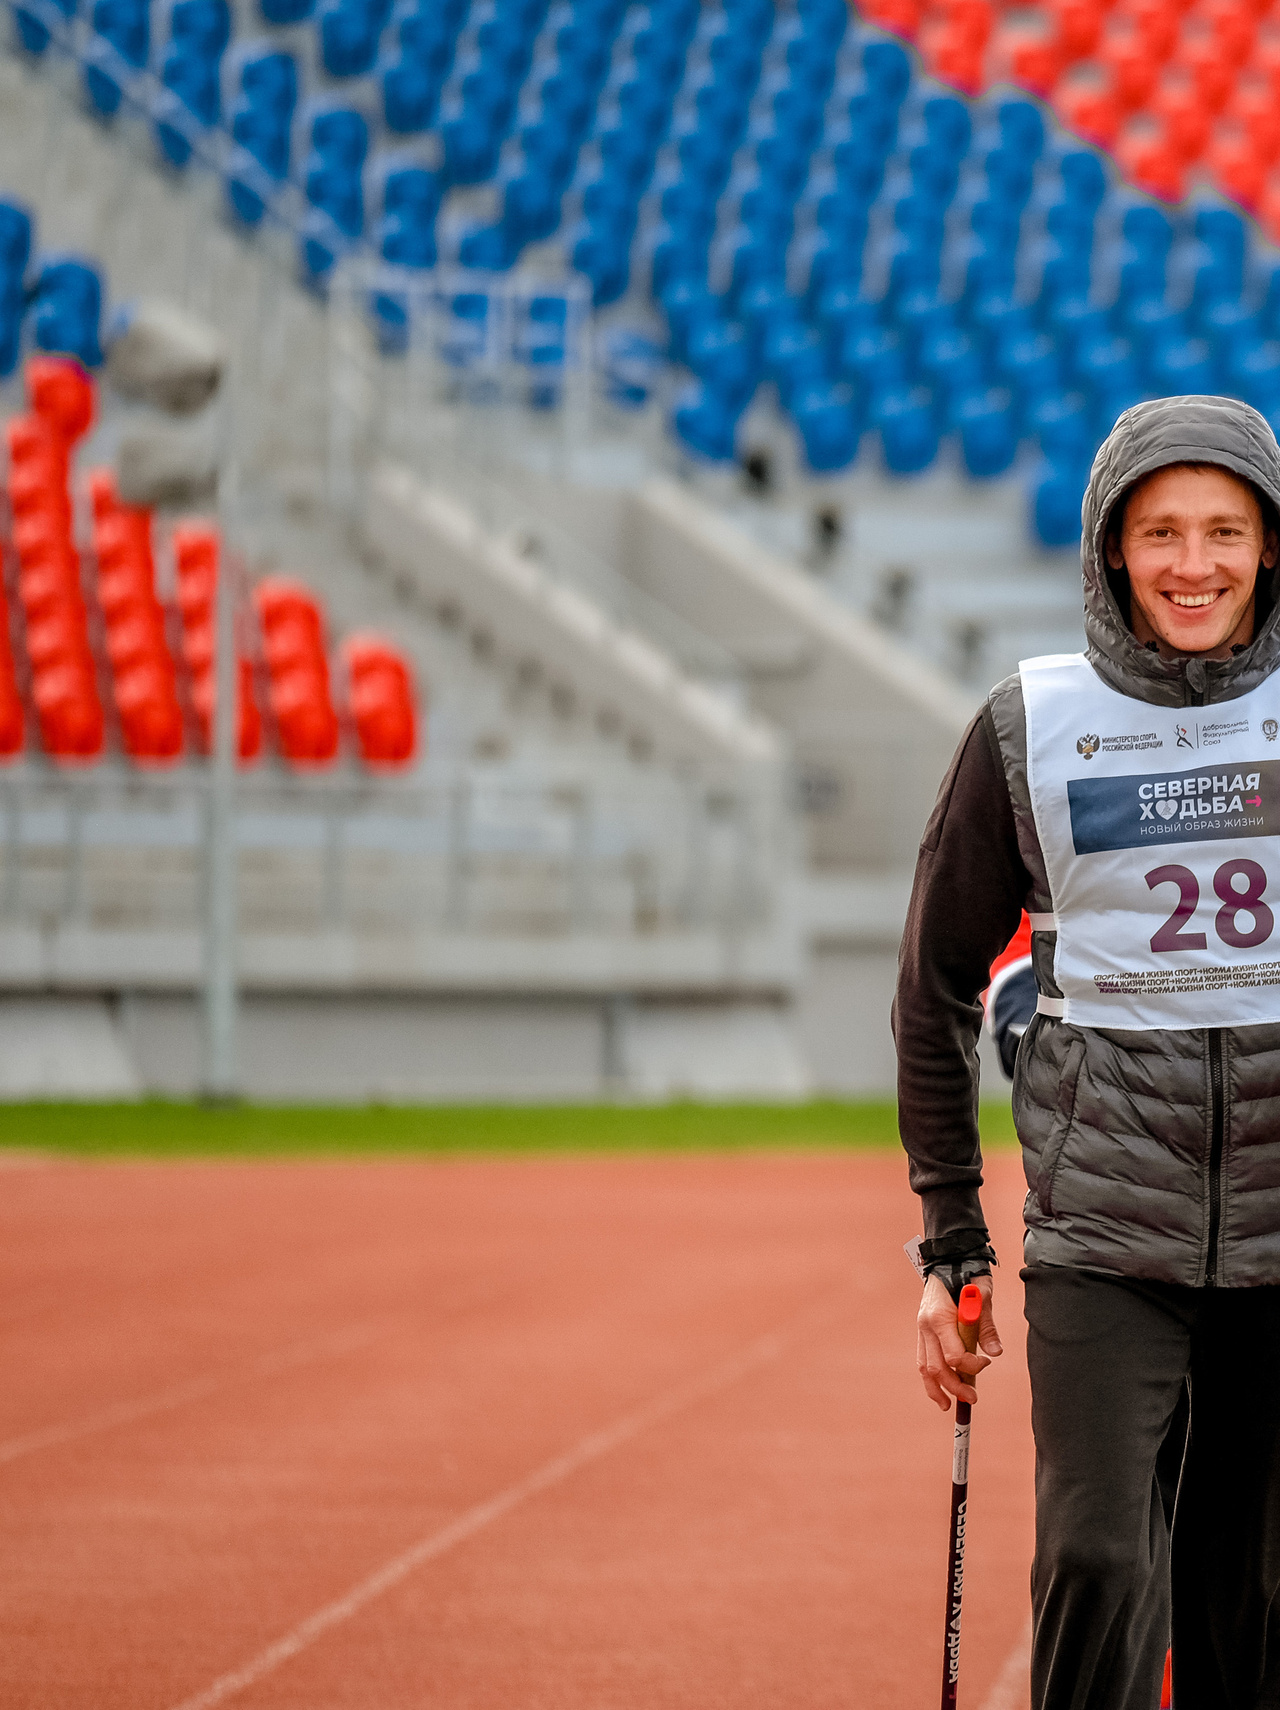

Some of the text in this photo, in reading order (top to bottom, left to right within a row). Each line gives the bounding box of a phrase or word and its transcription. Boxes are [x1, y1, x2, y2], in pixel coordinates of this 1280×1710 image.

[1202, 720, 1249, 731] Добровольный
[1102, 733, 1157, 744] МИНИСТЕРСТВО СПОРТА
[1202, 727, 1250, 738] Физкультурный
[1102, 741, 1163, 752] РОССИЙСКОЙ ФЕДЕРАЦИИ
[1138, 772, 1260, 800] СЕВЕРНАЯ
[1140, 817, 1264, 835] НОВЫЙ ОБРАЗ ЖИЗНИ
[1144, 858, 1274, 953] 28
[1146, 970, 1173, 978] ЖИЗНИ
[1232, 964, 1258, 972] ЖИЗНИ
[1120, 979, 1146, 987] ЖИЗНИ
[1204, 973, 1231, 982] ЖИЗНИ
[1176, 984, 1204, 993] ЖИЗНИ
